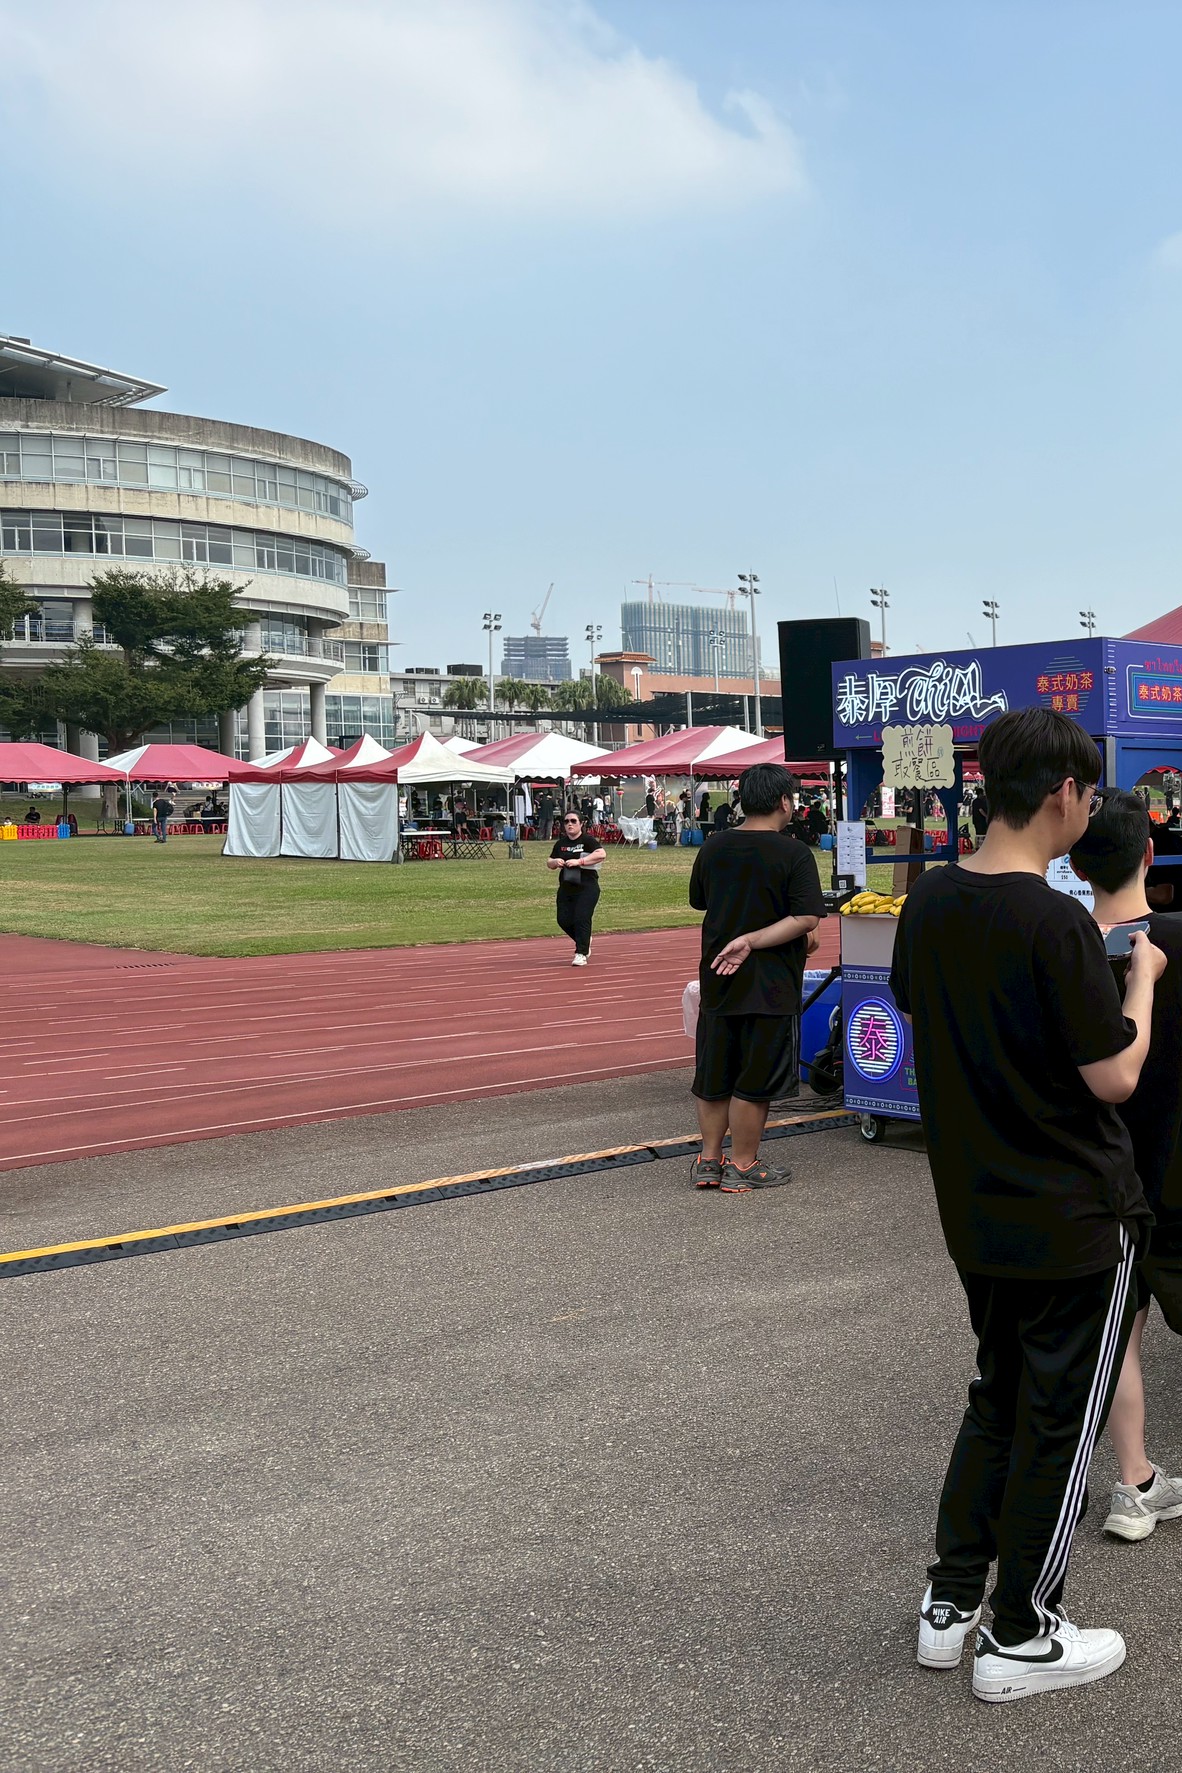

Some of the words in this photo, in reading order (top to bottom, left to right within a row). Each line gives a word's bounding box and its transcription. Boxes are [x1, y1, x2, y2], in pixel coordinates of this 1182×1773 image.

[1037, 672, 1093, 693] 泰式奶茶
[1051, 694, 1079, 712] 專賣
[900, 728, 934, 757] 煎餅
[859, 1015, 889, 1061] 泰
[932, 1607, 951, 1617] NIKE
[934, 1616, 947, 1625] AIR
[1000, 1686, 1013, 1695] AIR
